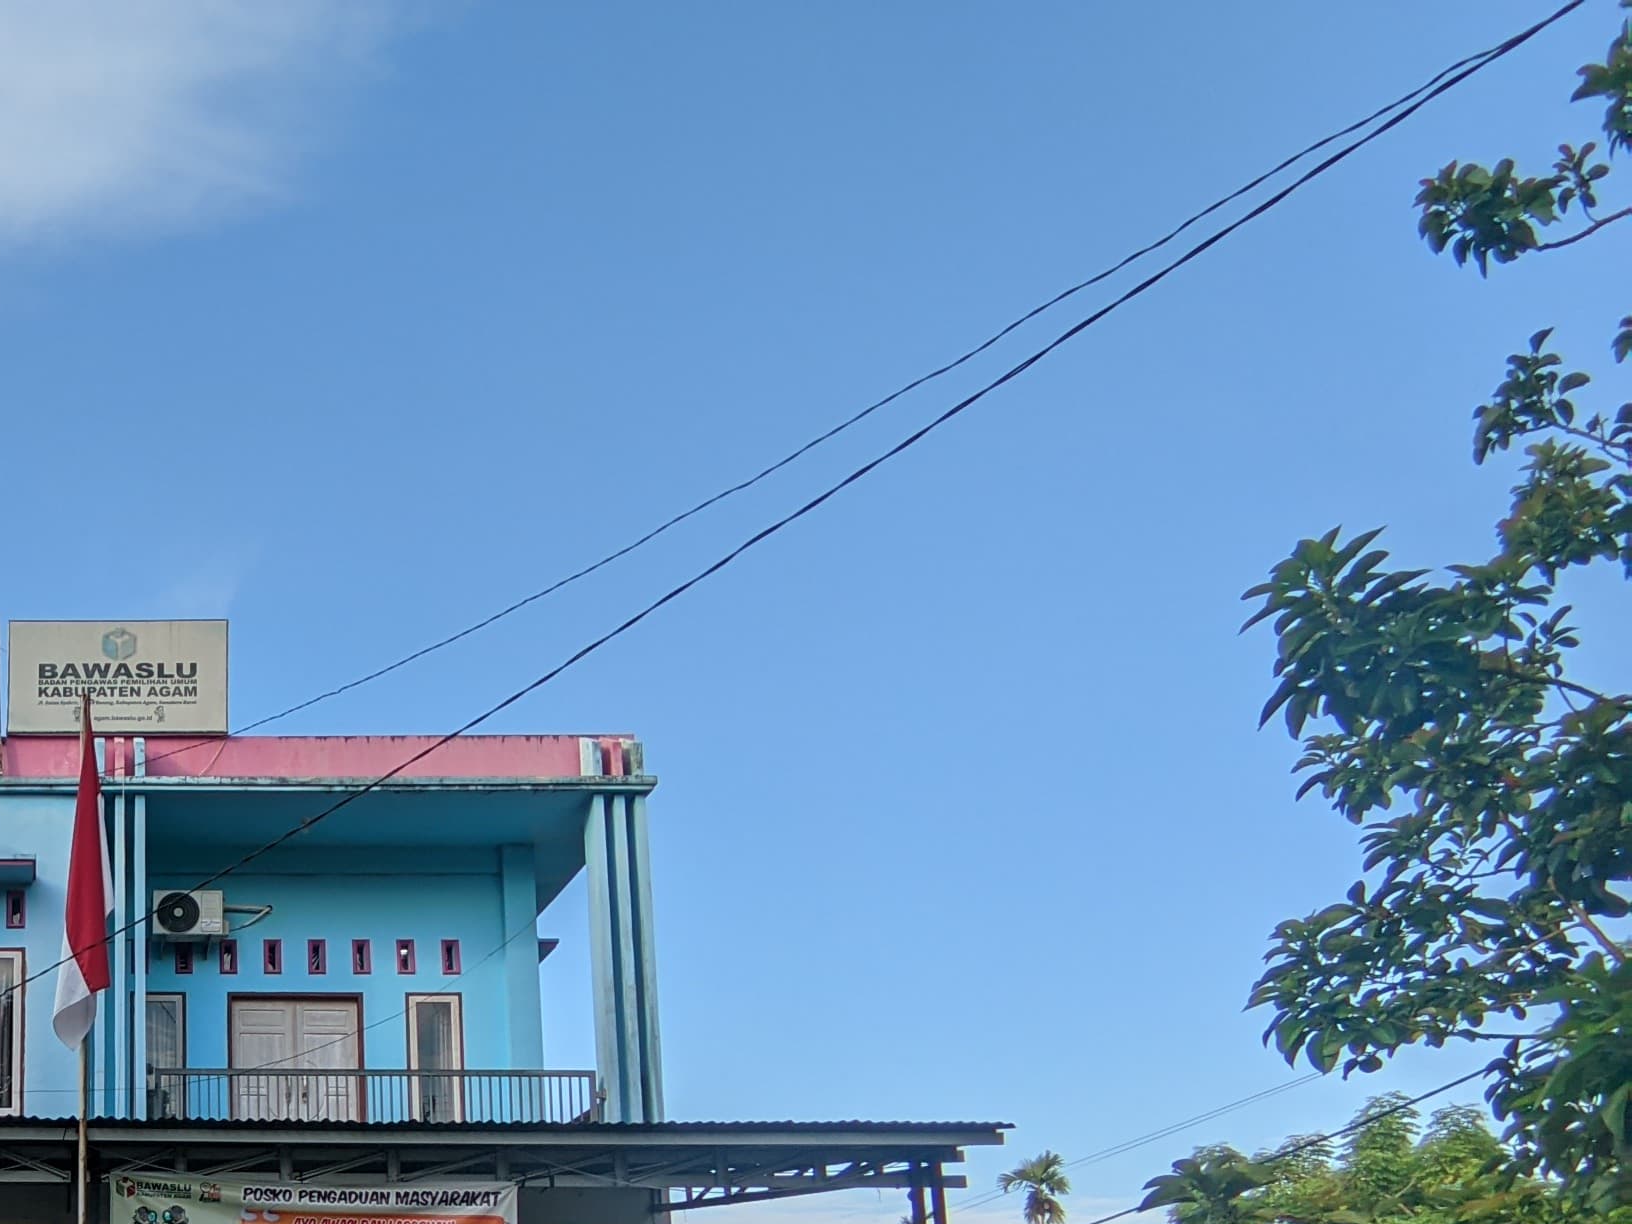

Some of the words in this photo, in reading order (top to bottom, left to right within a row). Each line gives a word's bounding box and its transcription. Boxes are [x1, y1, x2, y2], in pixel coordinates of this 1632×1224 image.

[38, 662, 198, 679] BAWASLU
[38, 686, 141, 698] KABUPATEN
[147, 685, 197, 698] AGAM
[137, 1181, 192, 1192] BAWASLU
[242, 1187, 293, 1202] POSKO
[298, 1189, 391, 1205] PENGADUAN
[395, 1190, 501, 1207] MASYARAKAT
